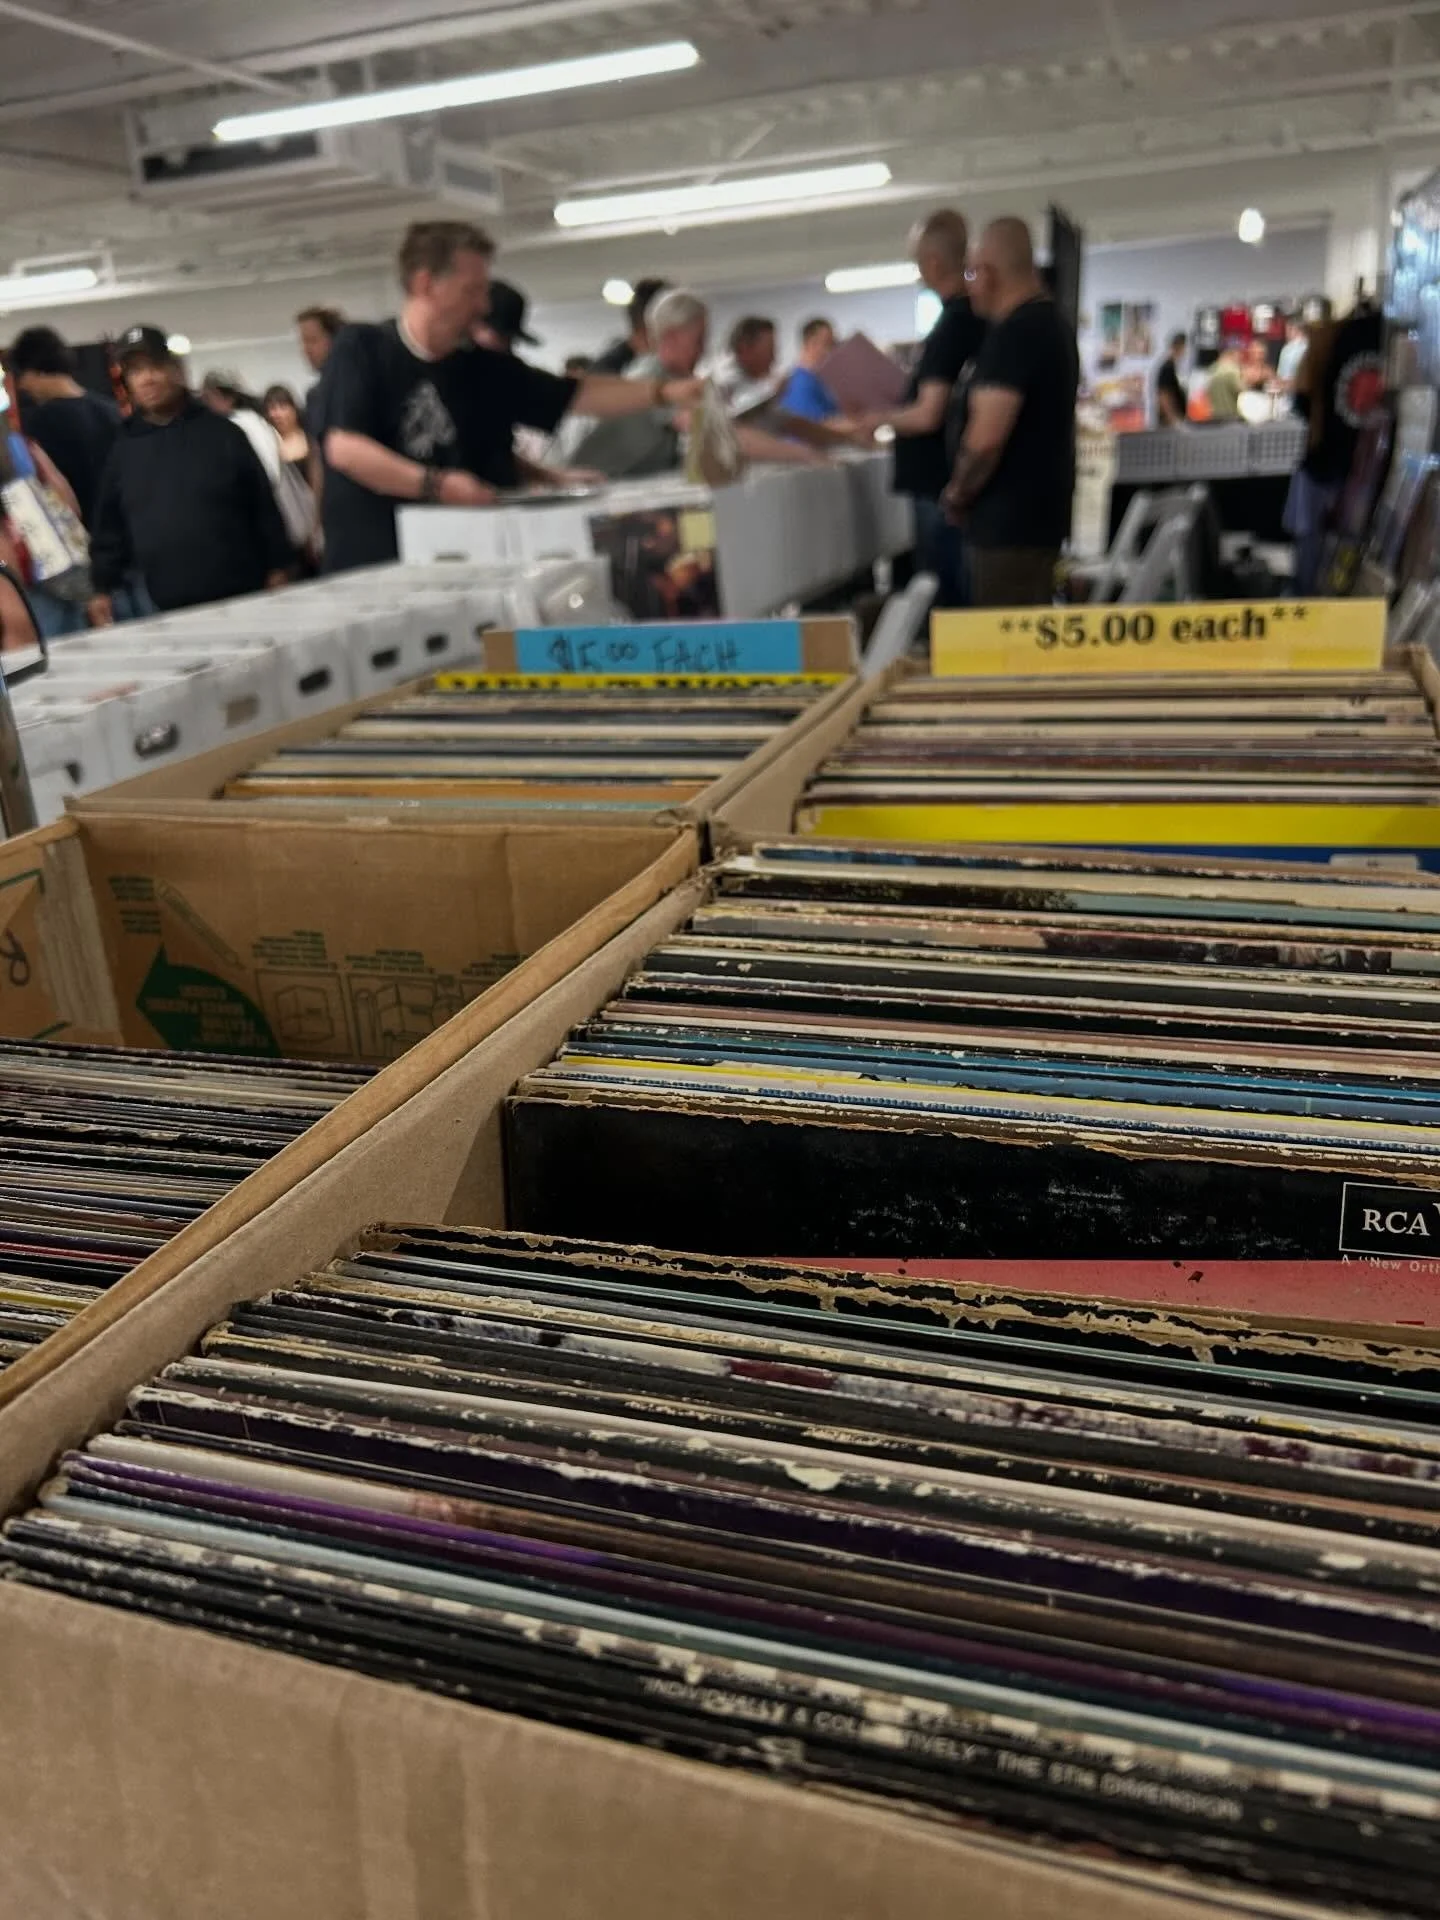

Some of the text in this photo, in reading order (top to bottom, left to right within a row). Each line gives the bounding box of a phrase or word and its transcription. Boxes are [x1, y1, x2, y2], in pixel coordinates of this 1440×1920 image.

[1361, 1208, 1431, 1236] RCA
[1341, 1253, 1351, 1265] A
[997, 1750, 1043, 1779] THE
[1100, 1772, 1244, 1822] DIMENSION
